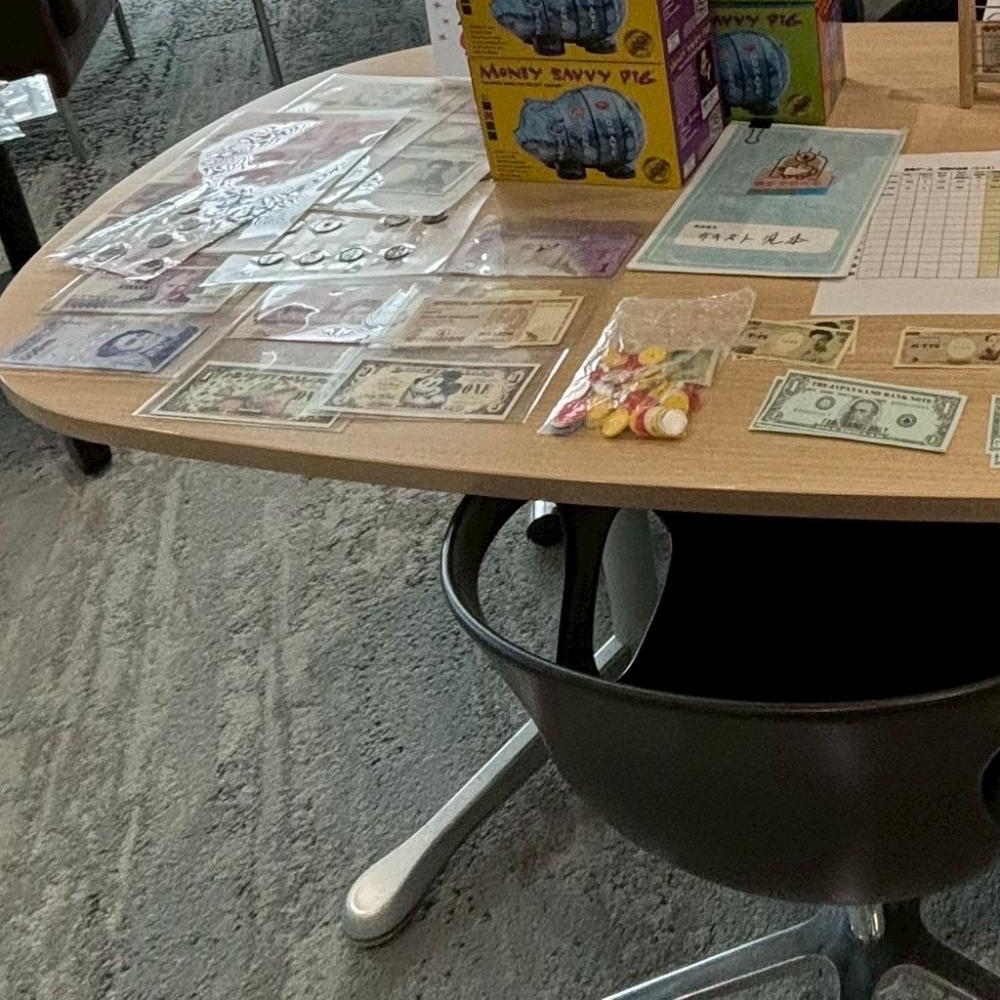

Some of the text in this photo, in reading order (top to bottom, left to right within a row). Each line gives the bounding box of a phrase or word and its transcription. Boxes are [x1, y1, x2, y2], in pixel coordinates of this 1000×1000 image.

[767, 13, 803, 27] PIG
[480, 63, 656, 85] MONEY SAVVY PIG
